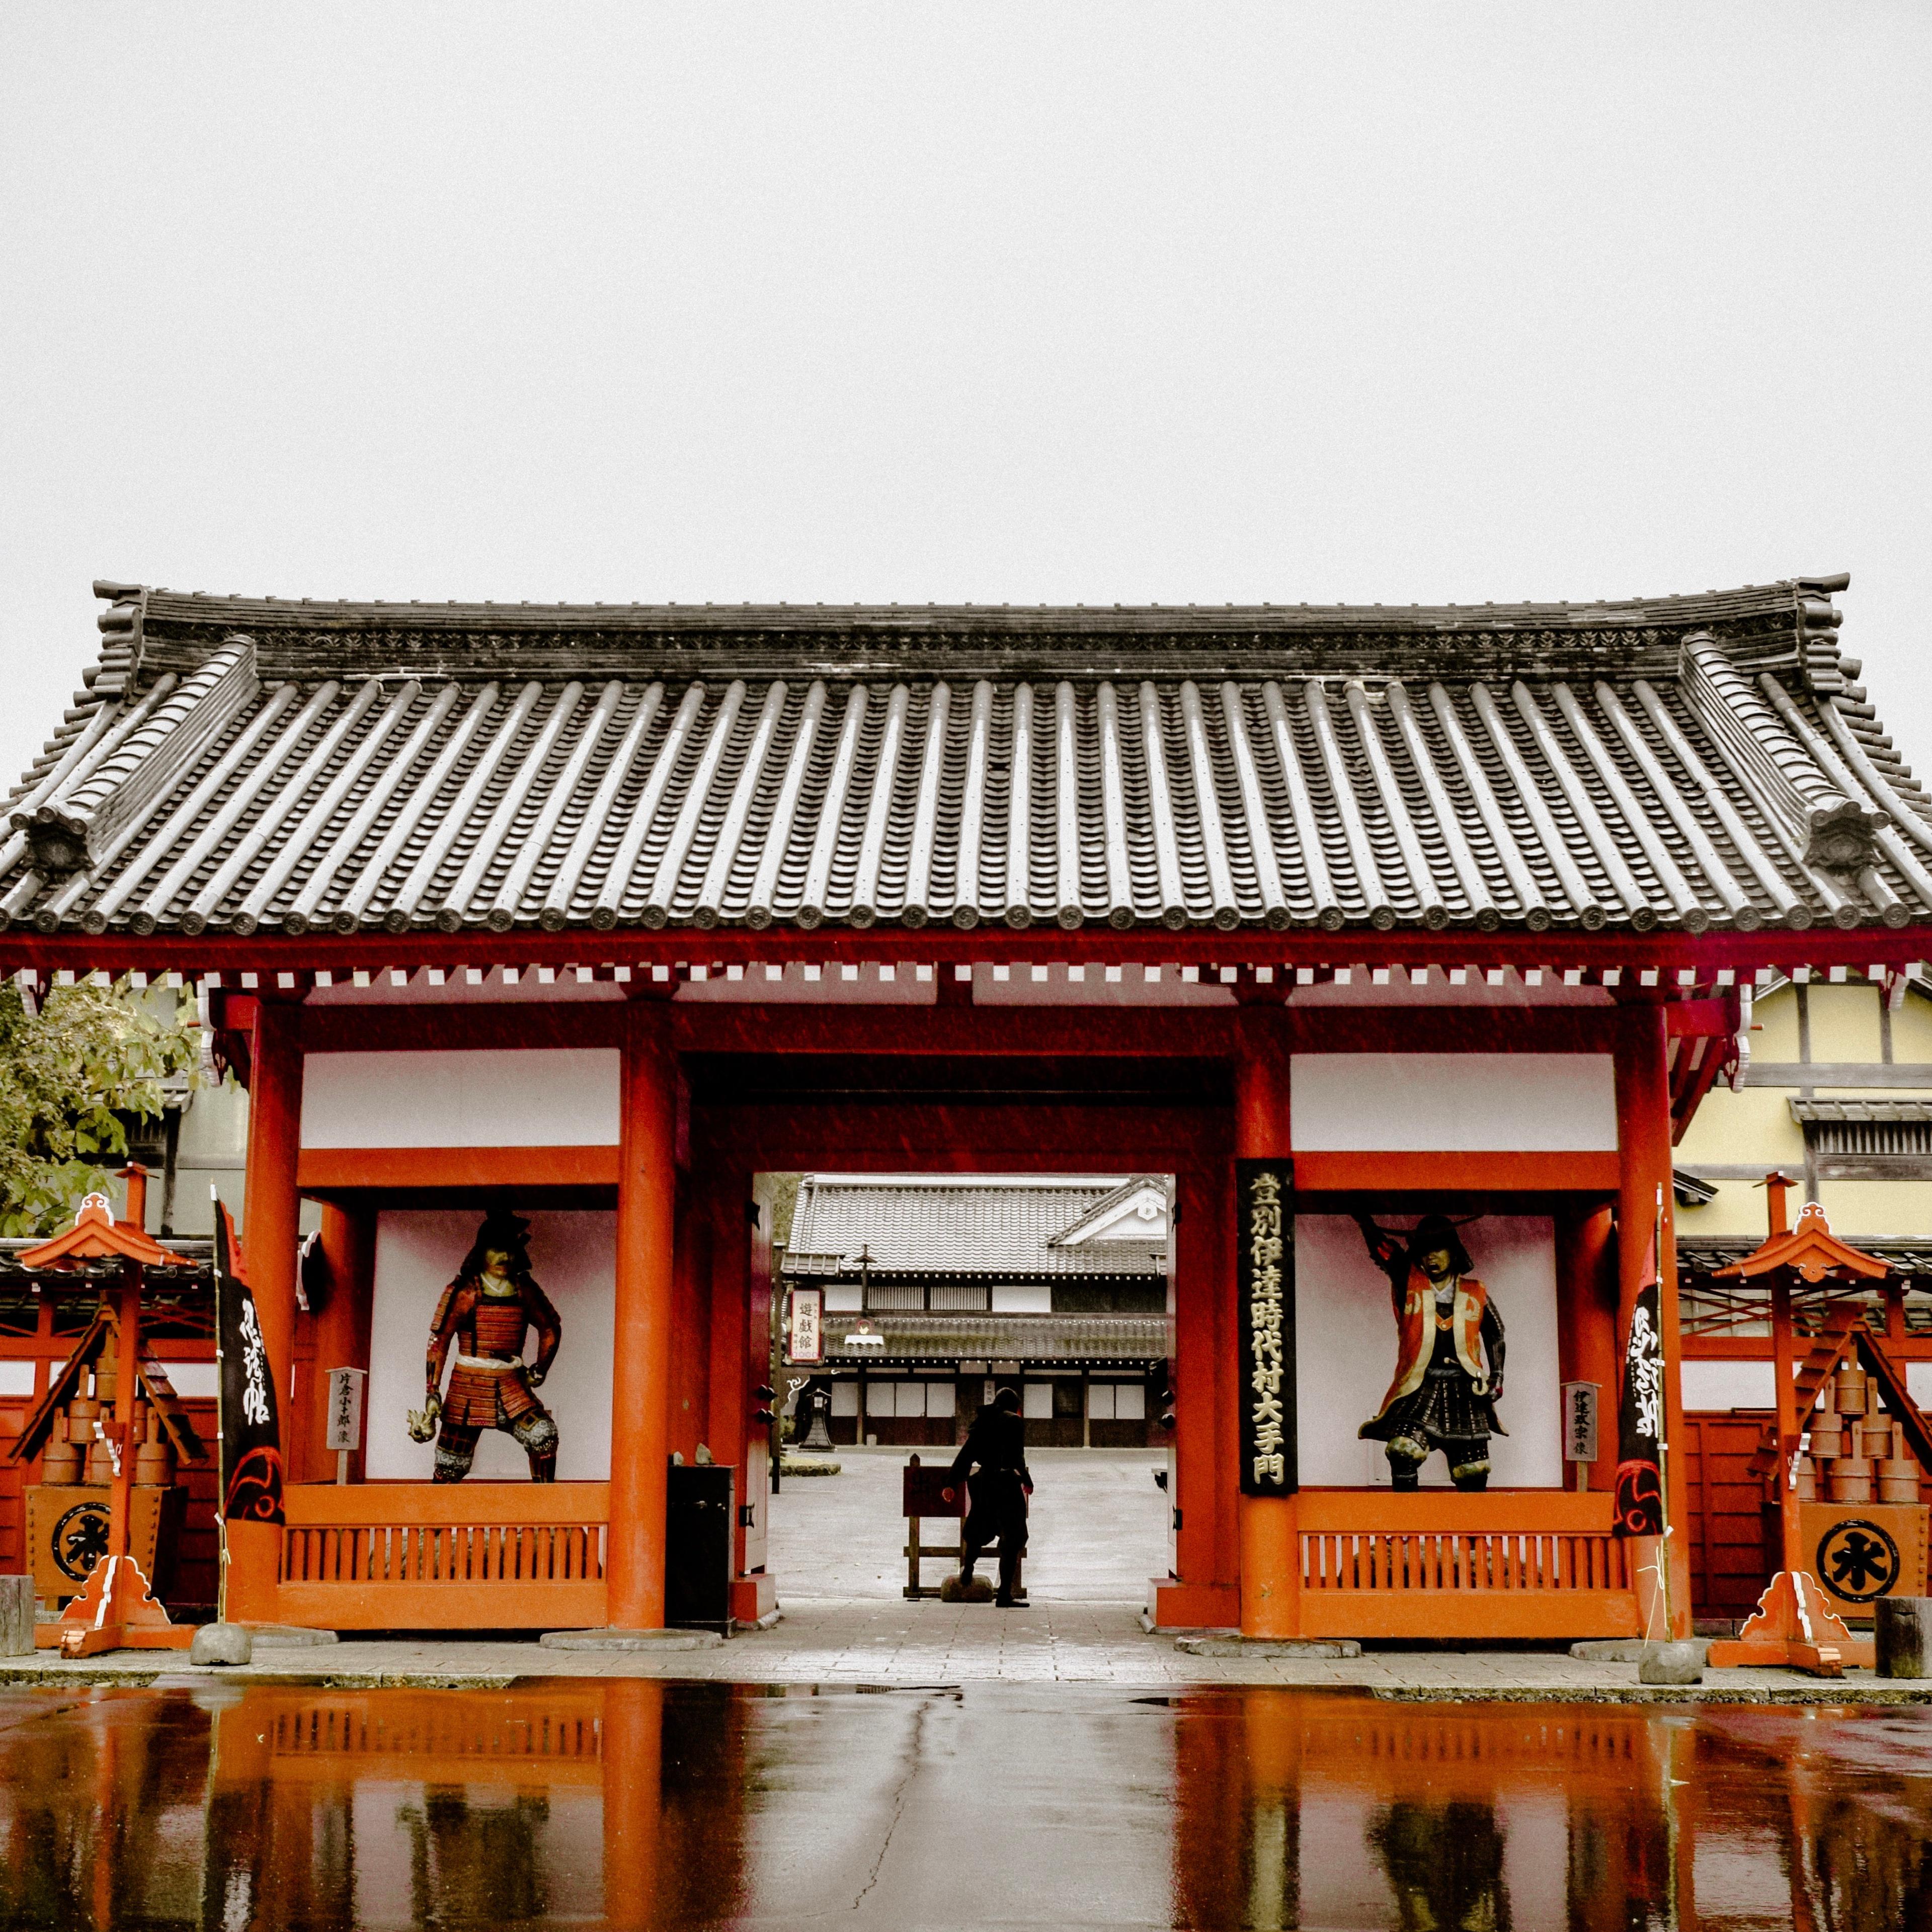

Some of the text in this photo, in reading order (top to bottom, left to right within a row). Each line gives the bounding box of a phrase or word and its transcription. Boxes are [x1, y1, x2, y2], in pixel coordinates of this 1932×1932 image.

[1249, 1172, 1285, 1485] 登別伊達時代村大手門
[1832, 1531, 1889, 1591] 水
